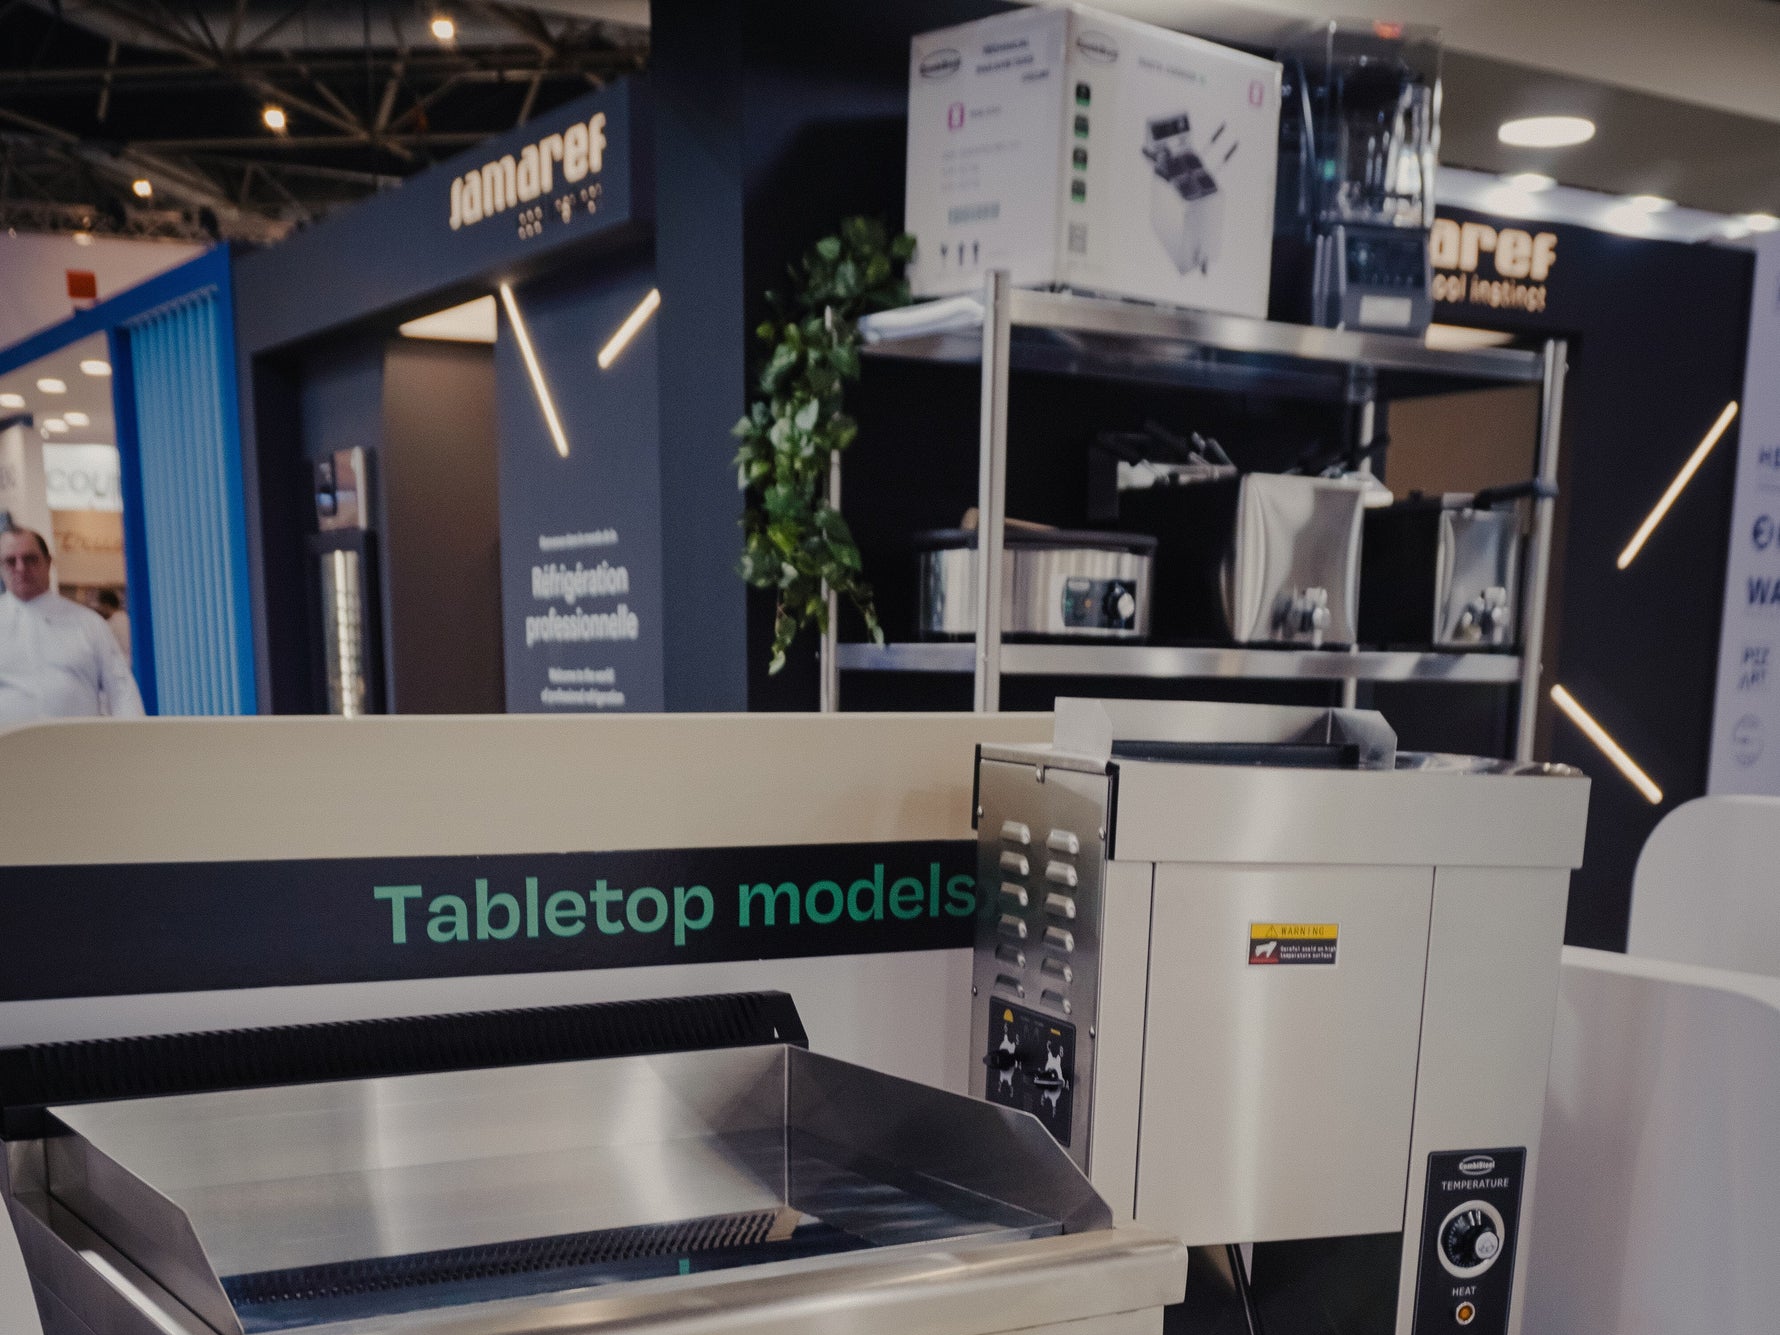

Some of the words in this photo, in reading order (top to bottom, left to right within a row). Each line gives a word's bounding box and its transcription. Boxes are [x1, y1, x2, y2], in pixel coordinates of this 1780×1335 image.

[532, 559, 628, 604] Réfrigération
[526, 603, 639, 648] professionnelle
[374, 876, 714, 946] Tabletop
[739, 862, 976, 928] models
[1282, 926, 1325, 936] WARNING
[1441, 1177, 1510, 1191] TEMPERATURE
[1452, 1286, 1476, 1296] HEAT
